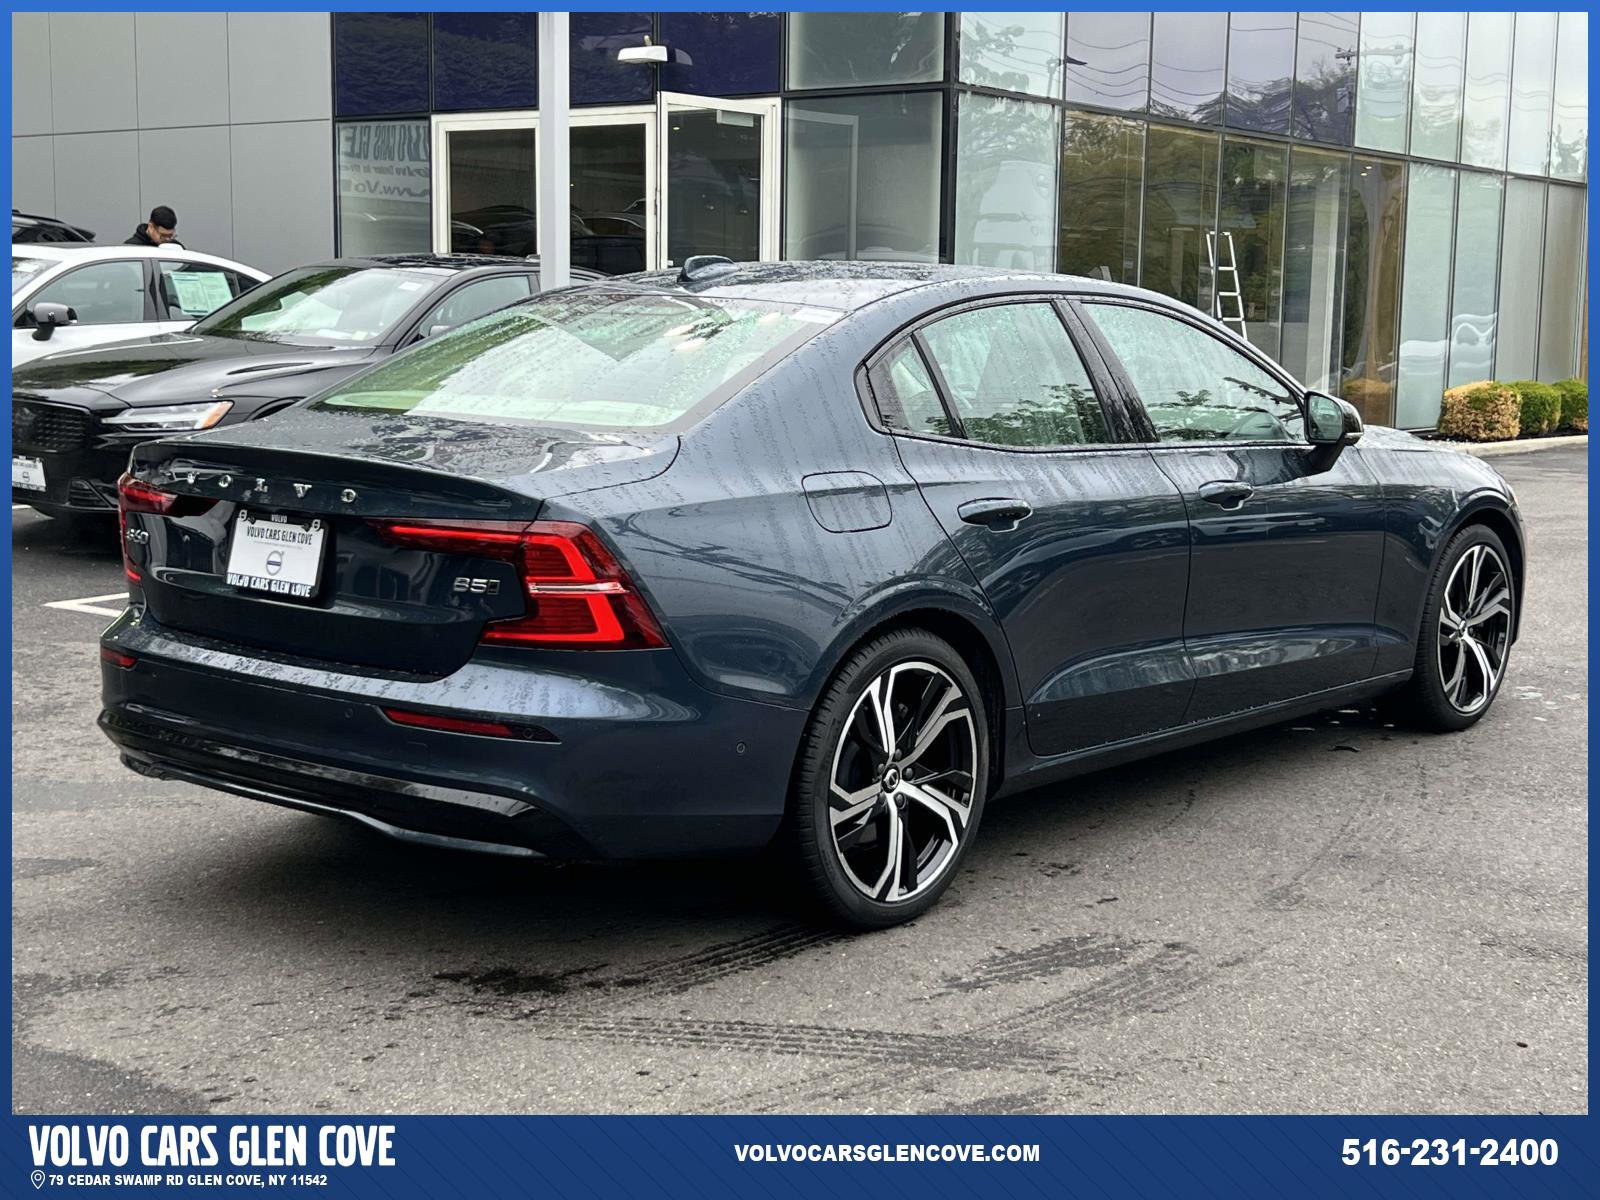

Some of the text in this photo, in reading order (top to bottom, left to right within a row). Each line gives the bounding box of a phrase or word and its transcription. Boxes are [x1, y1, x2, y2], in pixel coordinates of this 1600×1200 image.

[187, 471, 357, 503] VOLVO
[271, 514, 287, 523] VOLVO
[247, 525, 265, 539] VOLVO
[265, 528, 280, 540] CARS
[281, 530, 296, 543] GLEN
[297, 532, 313, 545] COVE
[226, 573, 312, 597] VOLVO CARS GLEN COVE
